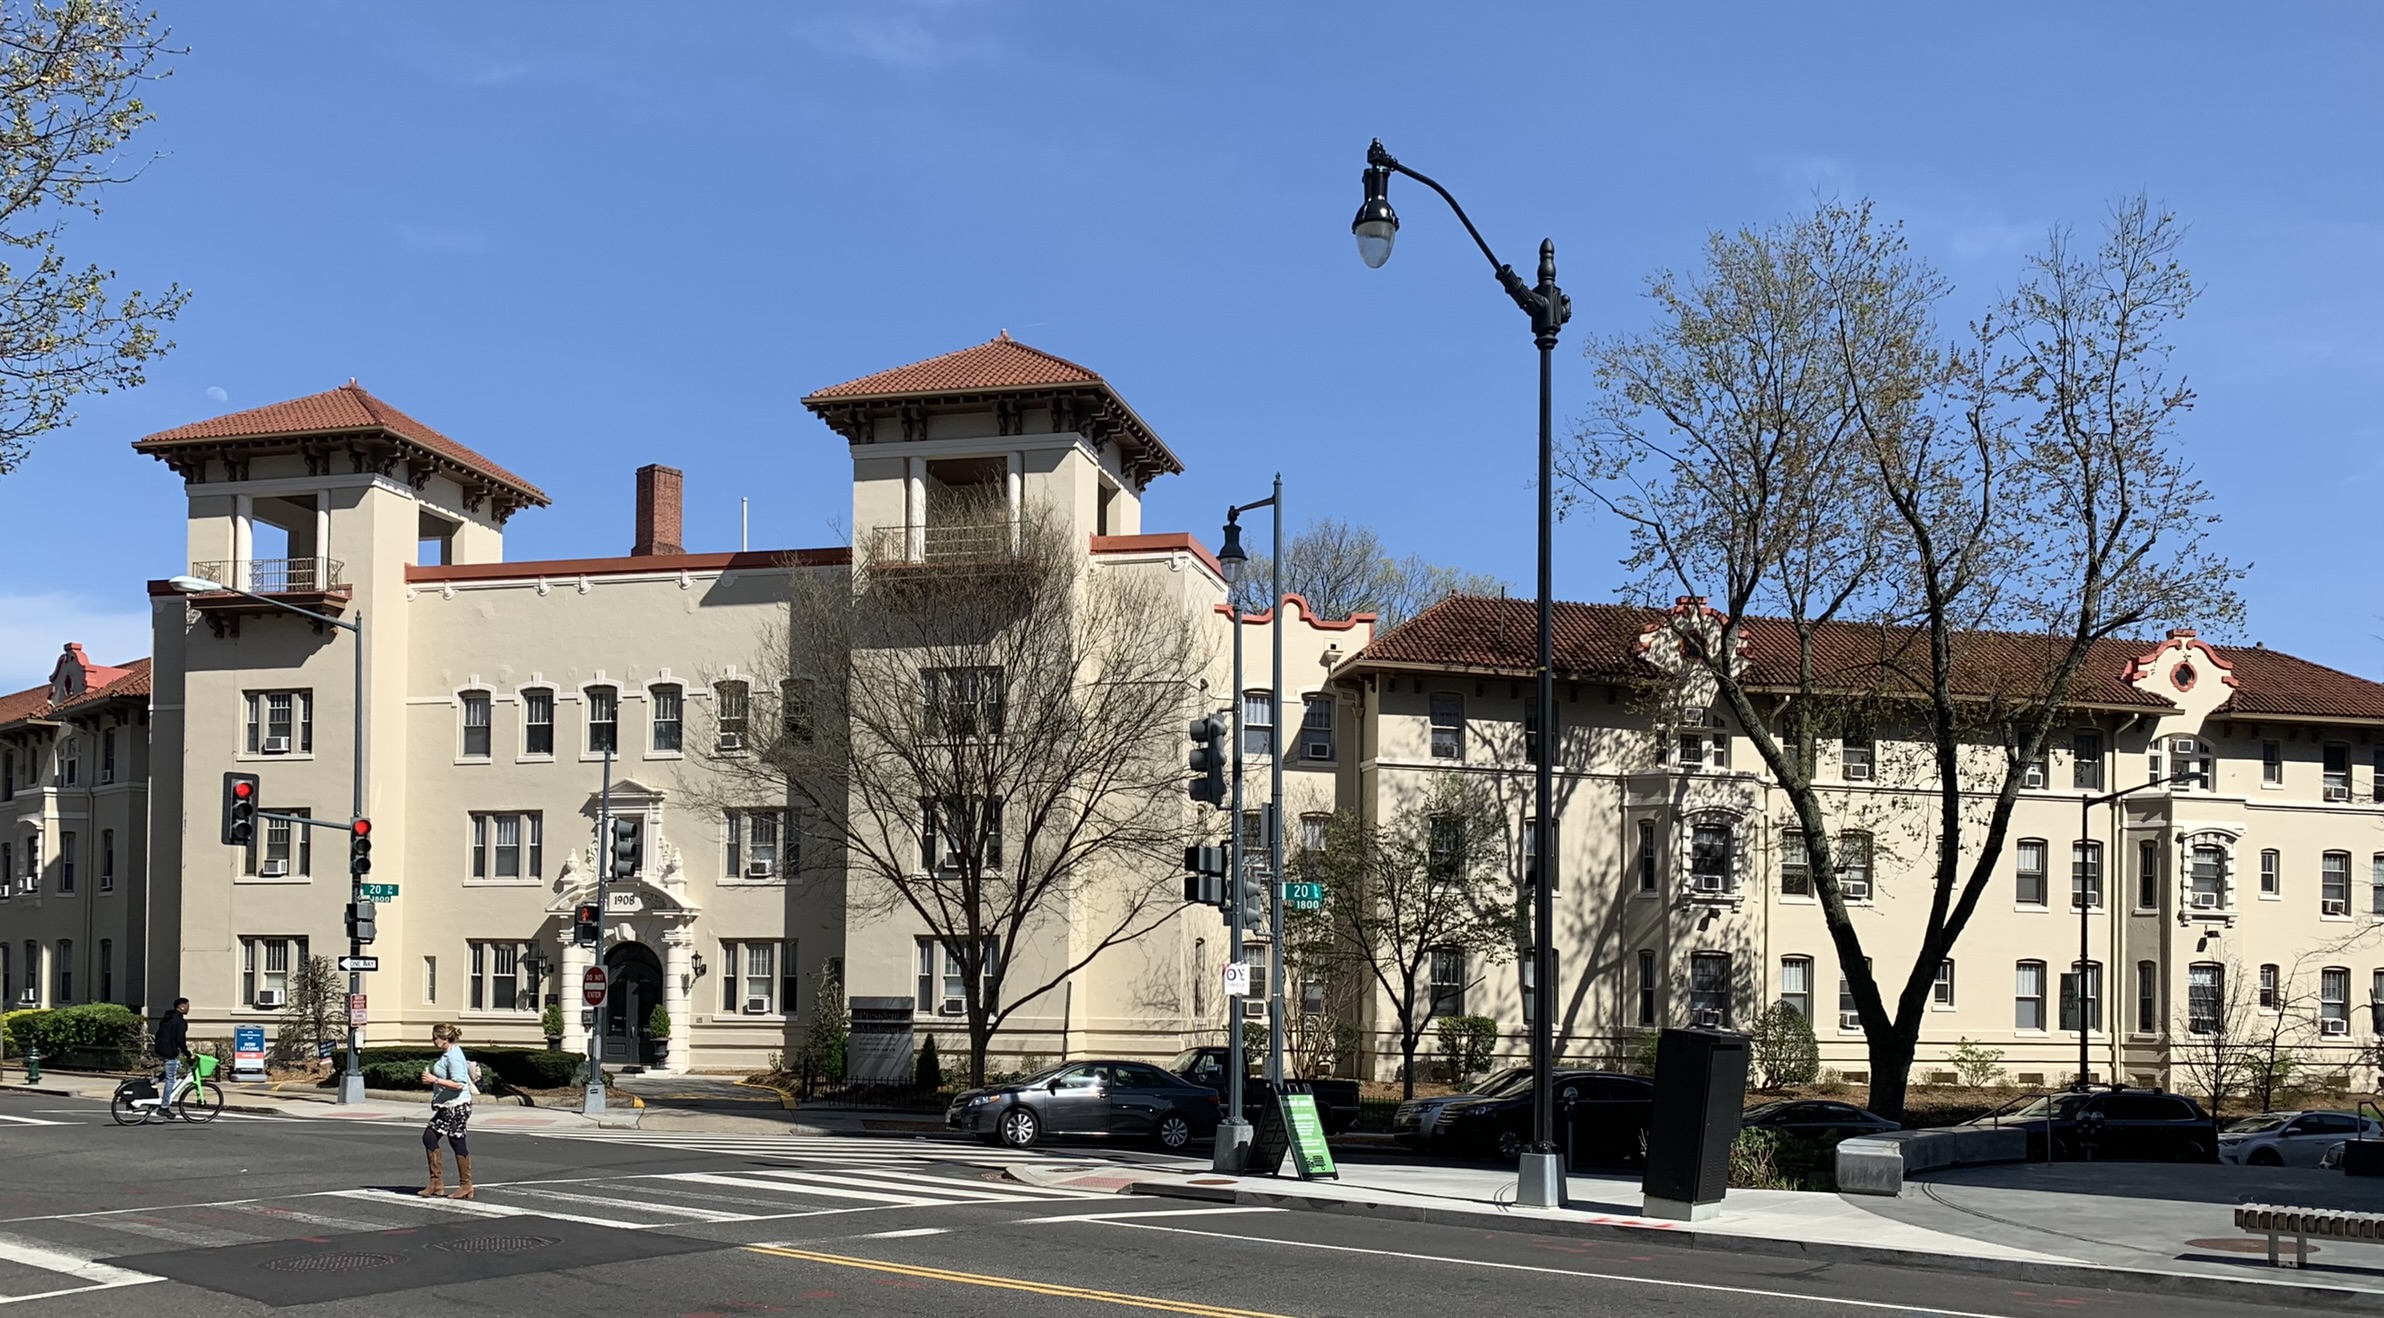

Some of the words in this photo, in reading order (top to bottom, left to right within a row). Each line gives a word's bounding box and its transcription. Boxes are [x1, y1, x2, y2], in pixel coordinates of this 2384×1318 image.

[369, 885, 381, 894] 20
[1293, 884, 1309, 898] 20
[614, 895, 635, 905] 1908
[1296, 900, 1319, 909] 1800
[860, 1010, 900, 1020] President
[861, 1023, 900, 1033] Madison
